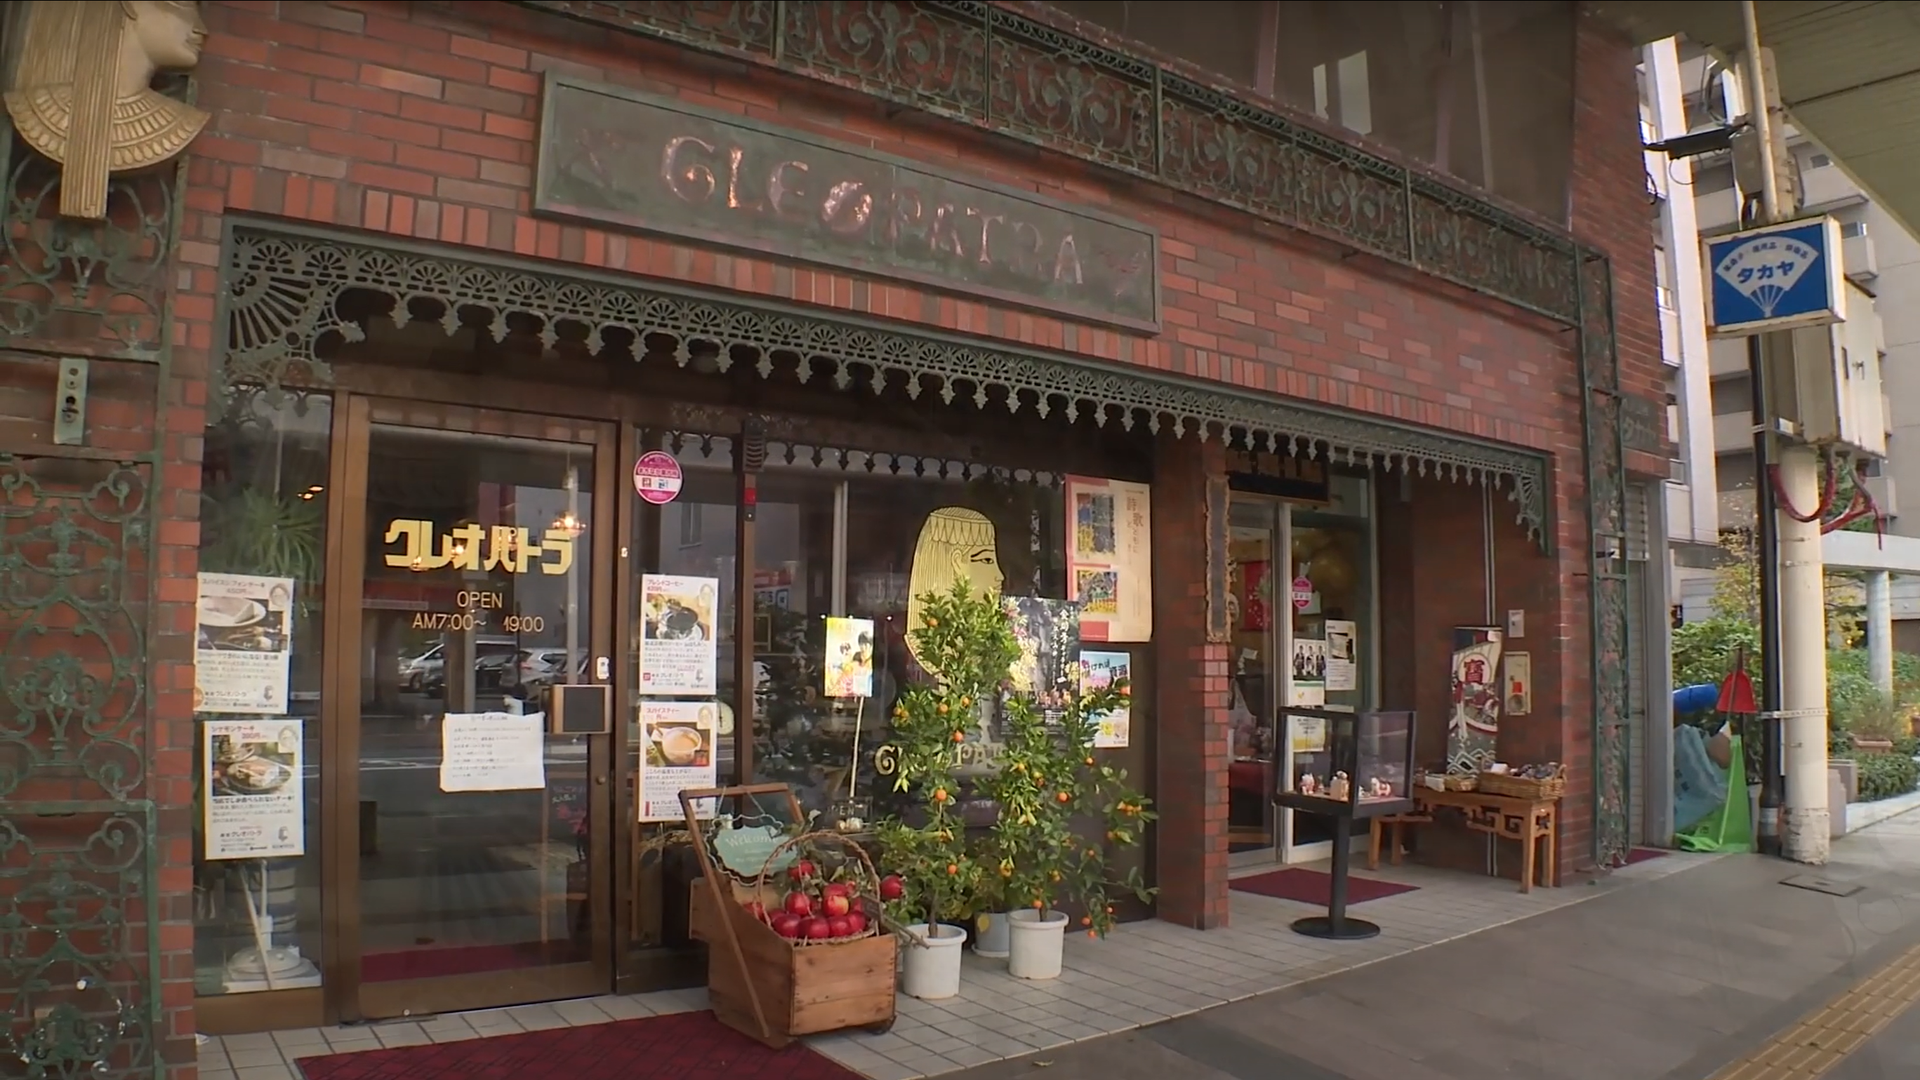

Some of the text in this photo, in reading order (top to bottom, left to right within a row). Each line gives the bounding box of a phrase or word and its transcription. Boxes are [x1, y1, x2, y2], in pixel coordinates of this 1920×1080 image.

[1736, 260, 1795, 284] タカヤ
[385, 518, 574, 575] クレオパトラ
[457, 590, 503, 608] OPEN
[504, 615, 544, 633] 19:00
[726, 833, 778, 848] Welcome
